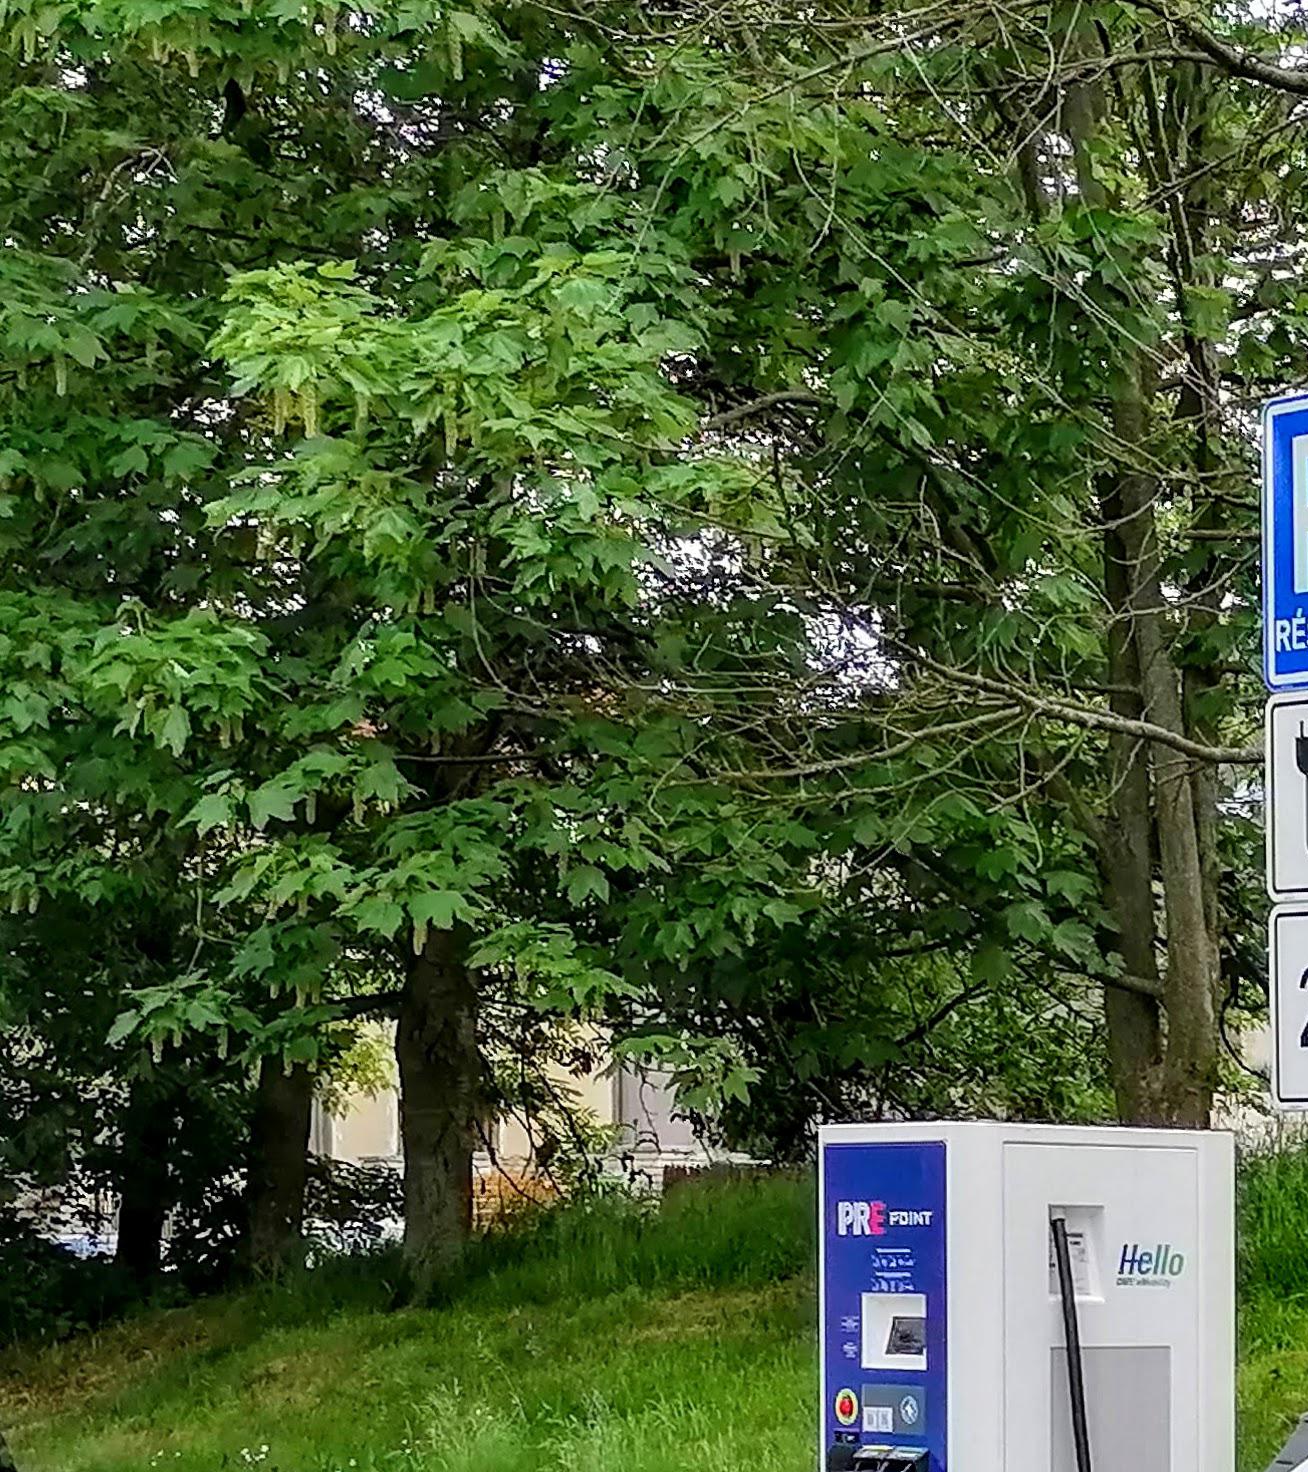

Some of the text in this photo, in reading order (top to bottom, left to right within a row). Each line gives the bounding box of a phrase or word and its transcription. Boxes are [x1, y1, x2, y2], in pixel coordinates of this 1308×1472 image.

[838, 1200, 933, 1236] PRE POINT
[1118, 1243, 1185, 1277] Hello
